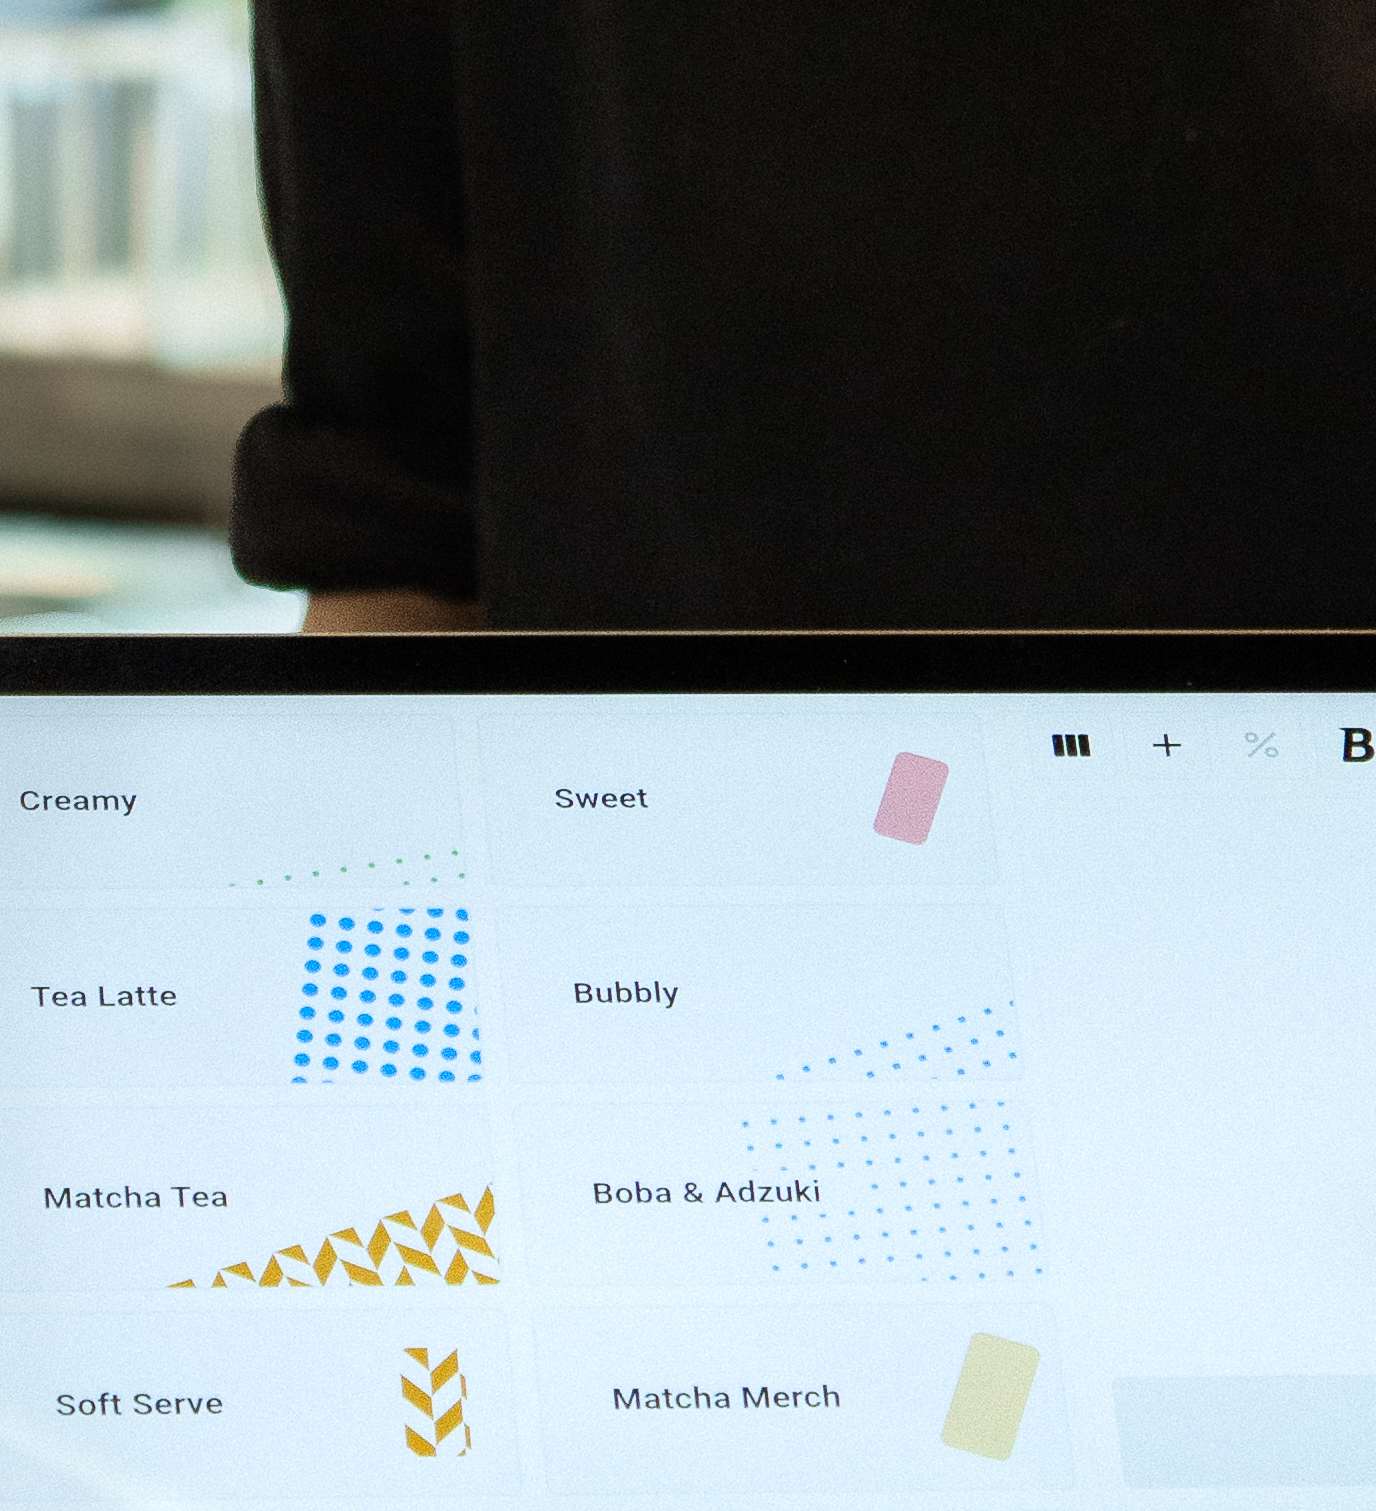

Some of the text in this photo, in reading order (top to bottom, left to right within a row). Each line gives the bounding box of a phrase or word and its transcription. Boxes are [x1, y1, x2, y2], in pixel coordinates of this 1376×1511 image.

[18, 788, 138, 817] Creamy
[553, 786, 649, 810] Sweet
[30, 984, 178, 1008] Tea Latte
[572, 979, 680, 1010] Bubbly
[42, 1184, 229, 1210] Matcha Tea
[591, 1178, 822, 1206] Boba & Adzuki
[55, 1390, 224, 1417] Soft Serve
[611, 1383, 842, 1411] Matcha Merch
